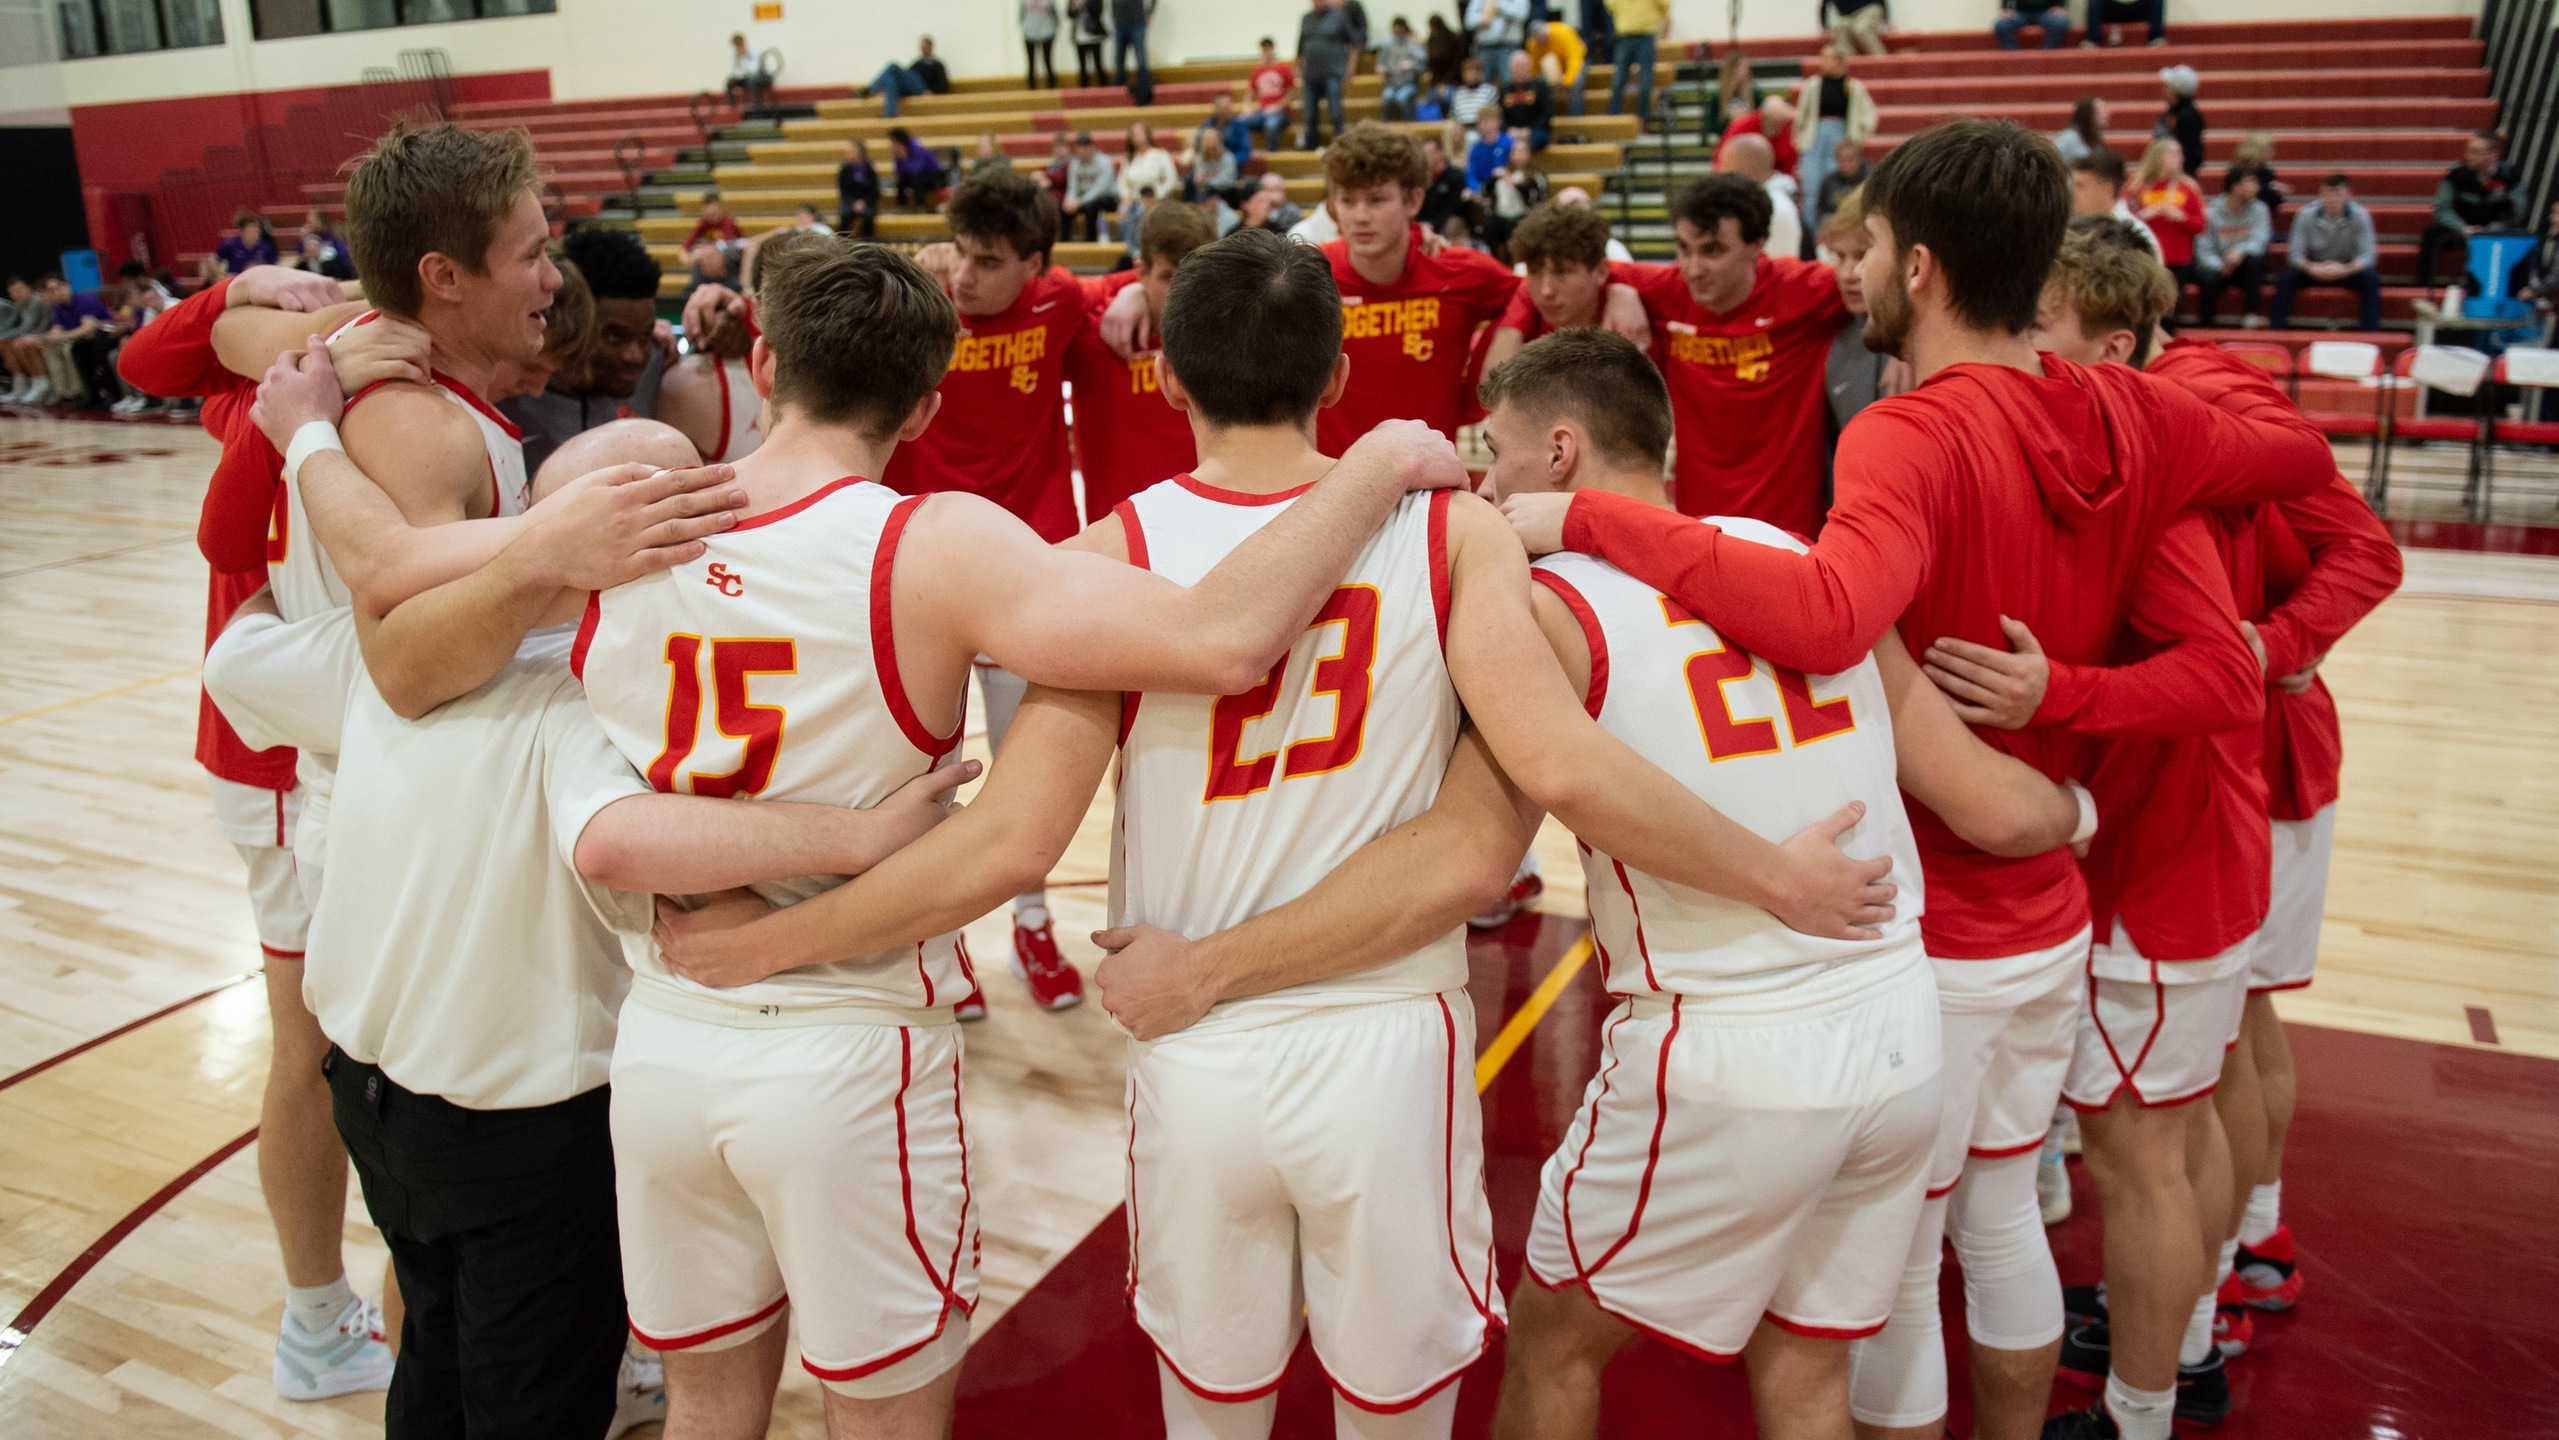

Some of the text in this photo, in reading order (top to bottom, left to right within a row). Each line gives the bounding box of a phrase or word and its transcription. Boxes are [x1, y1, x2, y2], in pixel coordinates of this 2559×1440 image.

[1402, 330, 1434, 362] SC
[1010, 364, 1039, 394] SC
[706, 562, 744, 597] SC
[1202, 583, 1382, 804] 23
[645, 631, 798, 799] 15
